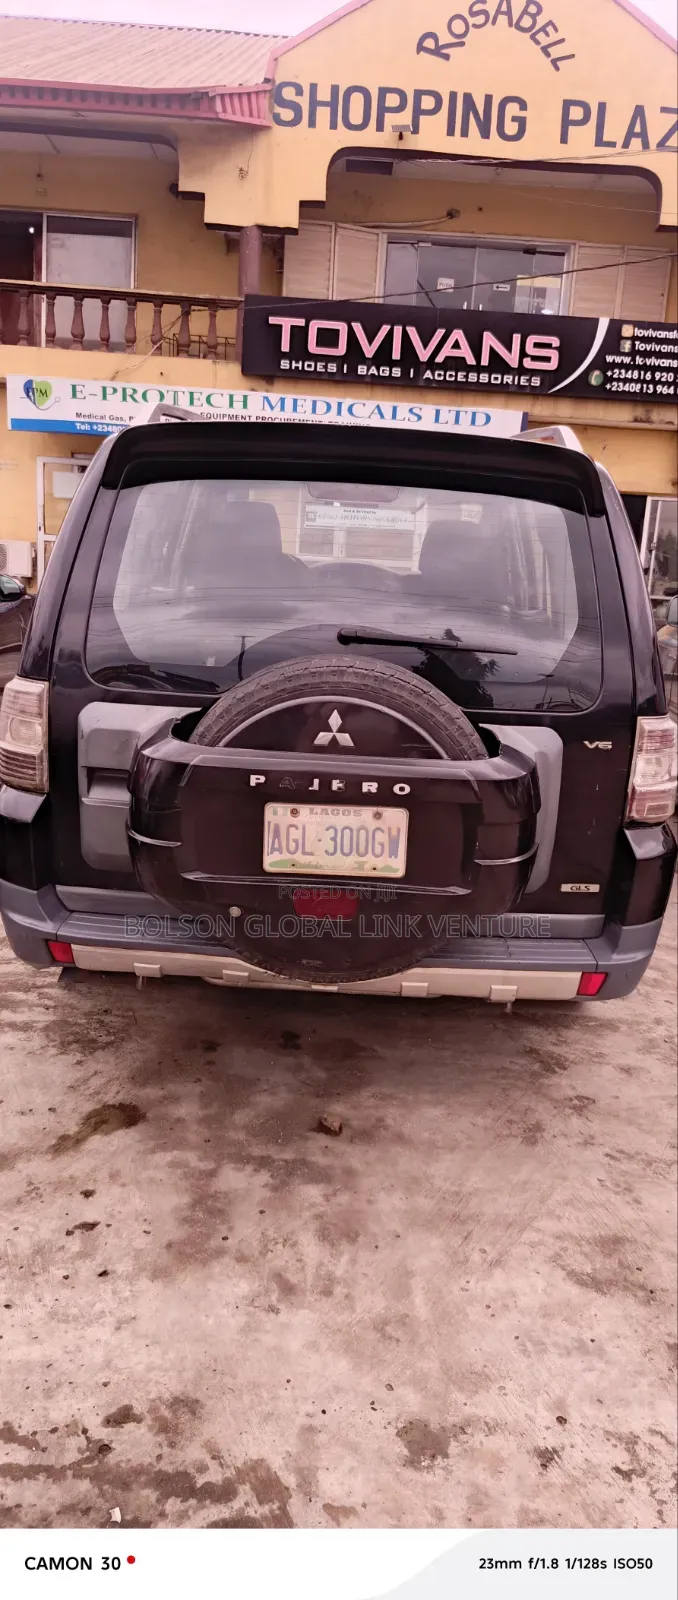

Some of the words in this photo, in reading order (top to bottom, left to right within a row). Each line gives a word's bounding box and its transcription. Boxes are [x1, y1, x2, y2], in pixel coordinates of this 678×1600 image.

[416, 0, 576, 71] ROSABELL
[272, 81, 528, 142] SHOPPING
[268, 316, 560, 371] TOVIVANS
[280, 359, 337, 374] SHOES
[357, 365, 401, 379] BAGS
[423, 369, 541, 386] ACCESSORIES
[655, 372, 674, 382] 920
[656, 385, 674, 395] 964
[70, 383, 249, 410] E-PROTECH
[261, 395, 423, 422] MEDICALS
[432, 408, 491, 427] LTD
[75, 412, 106, 421] Medical
[109, 414, 126, 422] Gas,
[582, 740, 613, 750] V6
[308, 807, 363, 817] LAGOS
